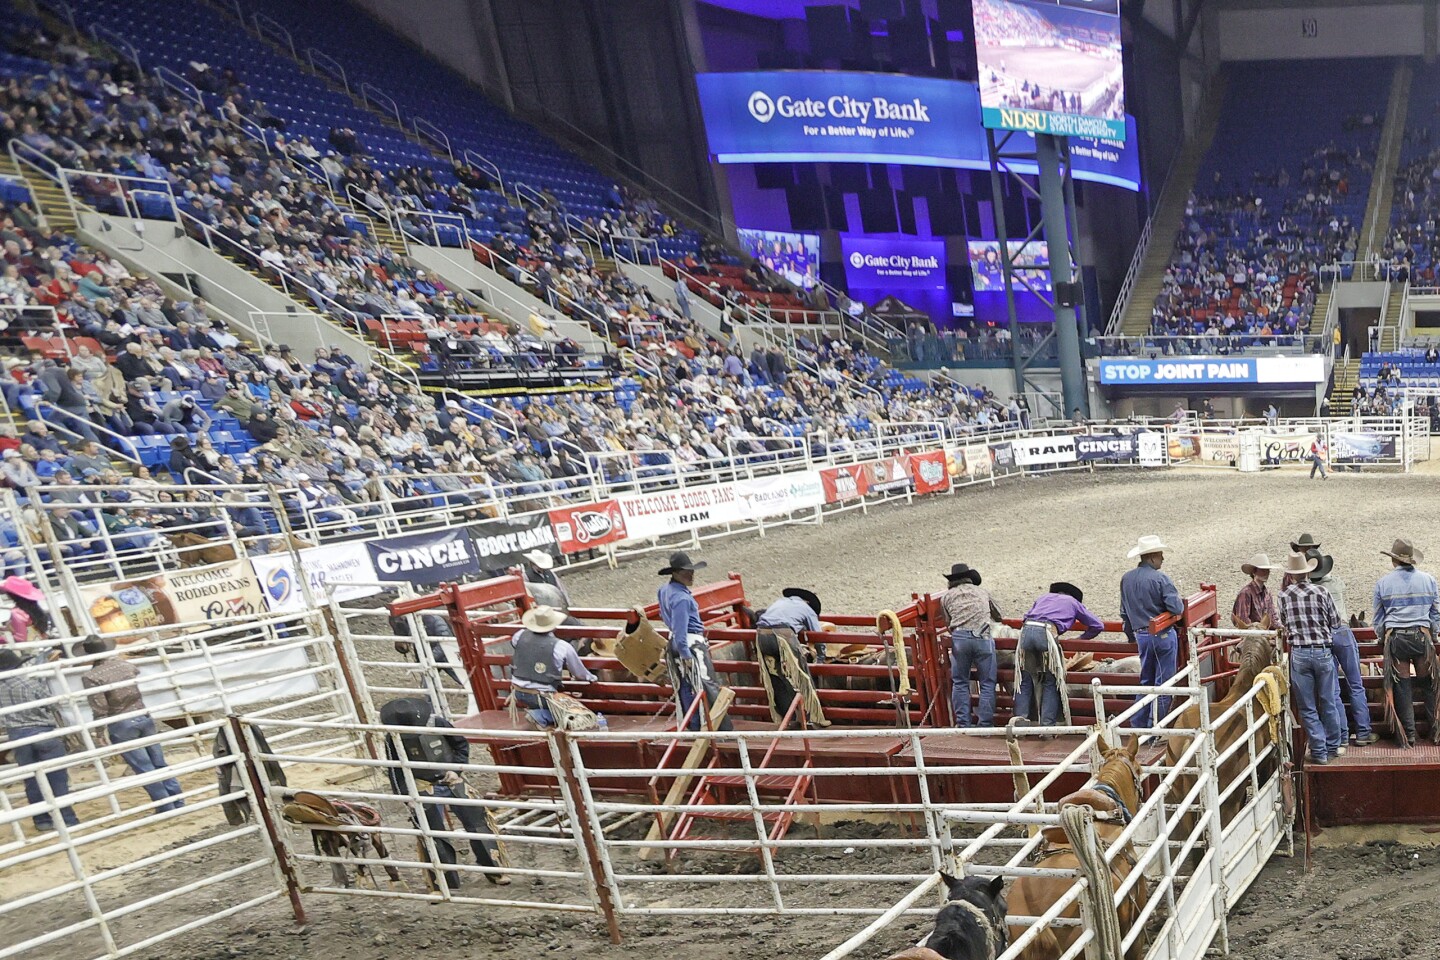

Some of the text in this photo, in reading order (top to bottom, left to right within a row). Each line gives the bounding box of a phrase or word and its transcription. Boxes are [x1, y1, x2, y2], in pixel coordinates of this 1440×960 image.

[777, 95, 931, 124] Gate City Bank
[1000, 109, 1047, 131] NDSU
[1049, 113, 1107, 129] NORTH DAKOTA
[803, 125, 819, 136] For
[820, 128, 827, 136] a
[828, 125, 856, 136] Better
[857, 126, 877, 139] Way
[878, 126, 888, 137] of
[1050, 123, 1117, 139] STATE UNIVERSITY
[864, 254, 938, 269] Gate City Bank
[1104, 362, 1249, 380] STOP JOINT PAIN
[1029, 444, 1074, 456] RAM
[1078, 440, 1133, 453] CINCH
[622, 486, 735, 518] WELCOME RODEO FANS
[571, 510, 613, 544] Justin
[678, 511, 710, 524] RAM
[475, 531, 519, 558] BOOT
[516, 524, 556, 550] BARN
[376, 539, 471, 574] CINCH
[169, 567, 233, 589] WELCOME
[174, 577, 251, 602] RODEO FANS
